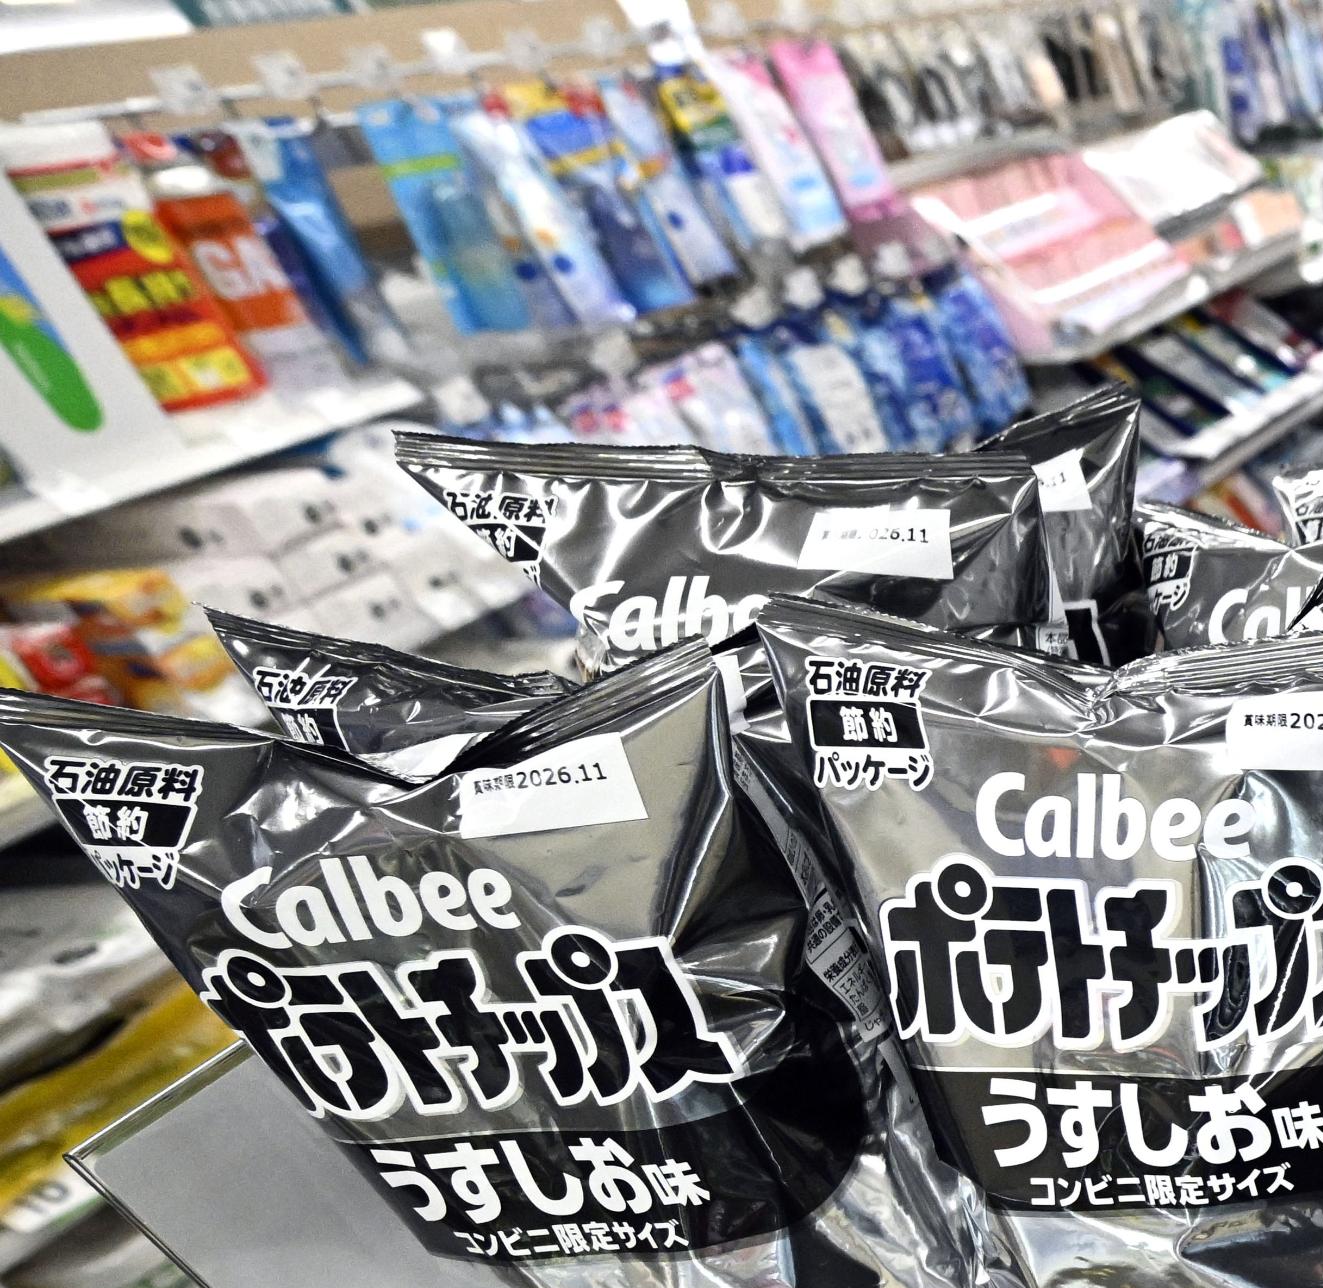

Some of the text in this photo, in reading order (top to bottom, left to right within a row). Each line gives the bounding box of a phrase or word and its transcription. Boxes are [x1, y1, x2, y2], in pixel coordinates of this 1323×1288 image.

[252, 665, 356, 707] 石油原料
[807, 660, 929, 700] 石油原料
[838, 706, 899, 744] 節約
[47, 758, 201, 803] 石油原料
[815, 753, 932, 789] パッケージ
[83, 804, 149, 841] 節約
[975, 771, 1253, 861] Calbee
[220, 855, 521, 950] Calbee
[203, 926, 745, 1121] ポテトチップス
[376, 1136, 711, 1225] うすしお味
[1029, 1164, 1296, 1207] コンビニ限定サイズ
[456, 1217, 689, 1258] コンビニ限定サイズ
